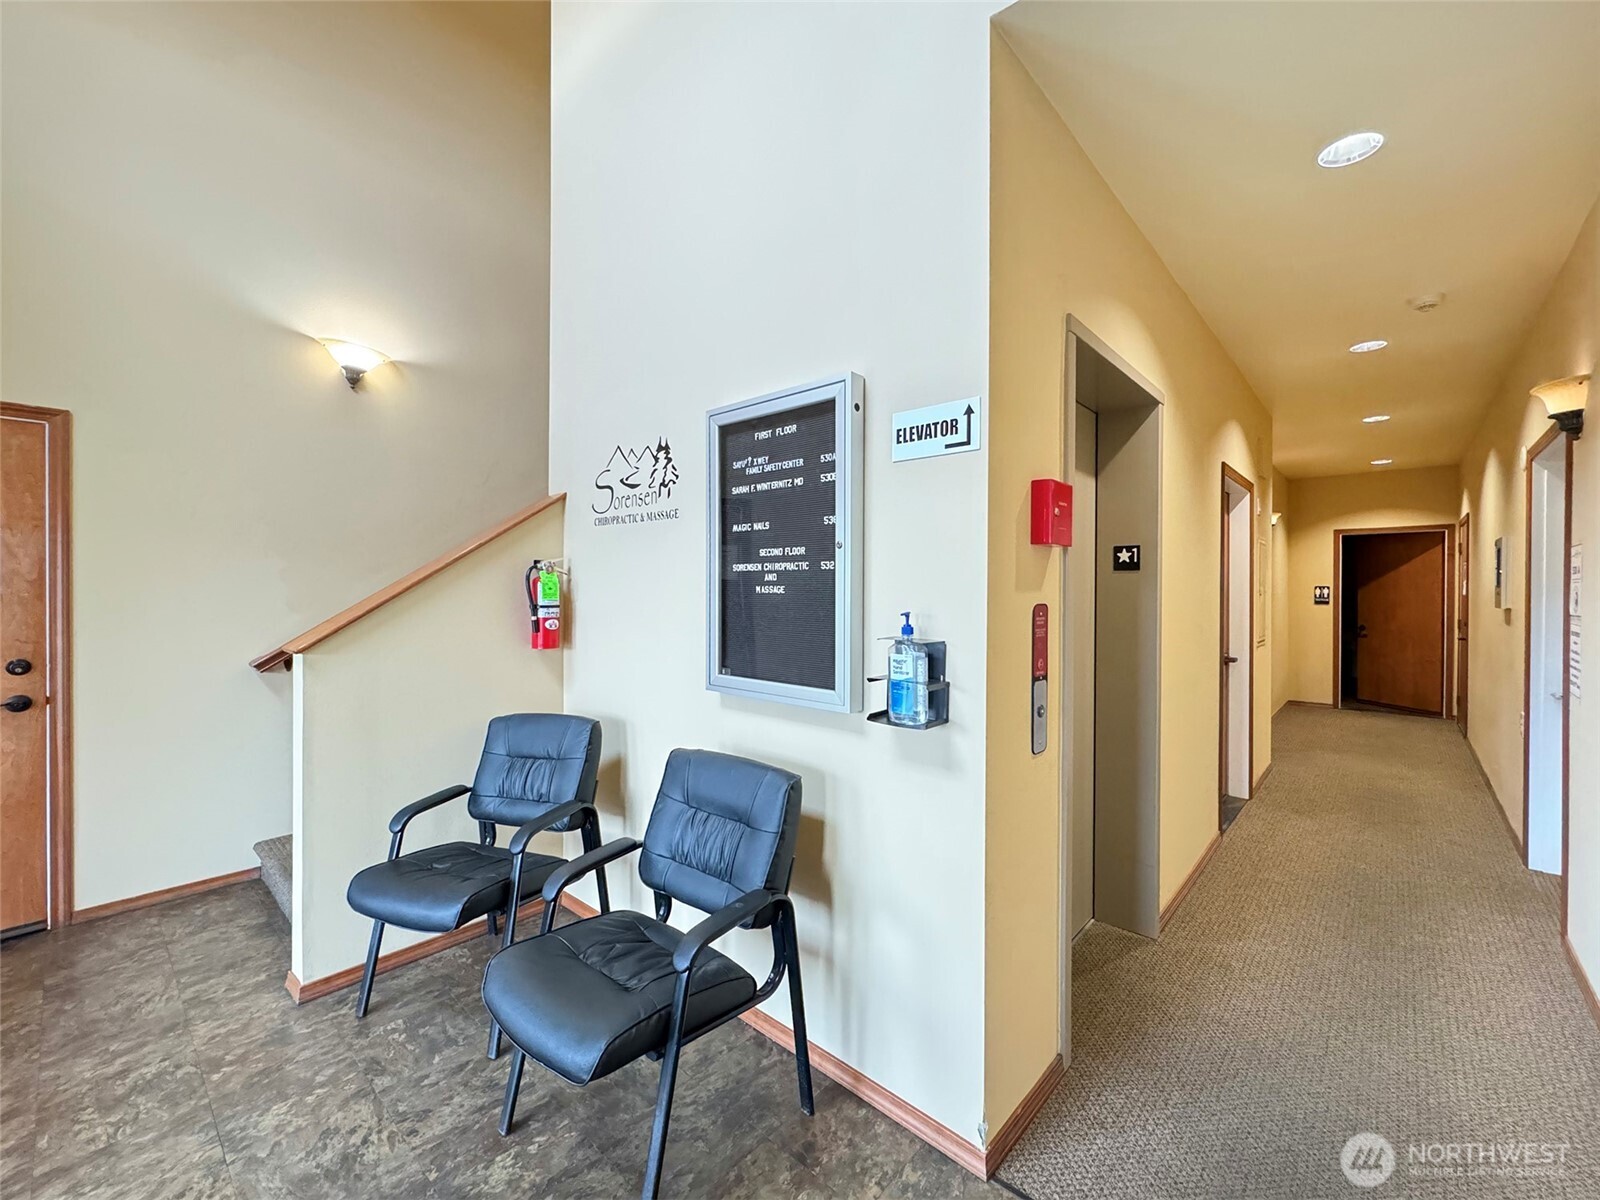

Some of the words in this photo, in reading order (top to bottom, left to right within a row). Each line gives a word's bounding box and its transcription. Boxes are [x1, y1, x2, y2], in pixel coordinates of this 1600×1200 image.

[754, 429, 773, 441] FIRST
[775, 424, 798, 437] FLOOR
[896, 418, 959, 445] ELEVATOR
[745, 464, 763, 476] FAMILY
[763, 462, 783, 473] SAFETY
[781, 458, 805, 470] CENTER
[591, 469, 658, 515] Sorensen
[731, 484, 750, 495] SARAH
[756, 478, 793, 492] WINTERNITZ
[793, 477, 804, 487] MD
[594, 513, 639, 527] CHIROPRACTIC
[640, 512, 646, 522] &
[646, 508, 680, 522] MASSAGE
[732, 523, 752, 533] MAGIC
[753, 521, 770, 531] NAILS
[759, 548, 783, 557] SECOND
[784, 546, 806, 556] FLOOR
[1132, 547, 1138, 563] 1
[732, 563, 762, 572] SORENSEN
[763, 561, 810, 571] CHIROPRACTIC
[820, 560, 835, 570] 532
[764, 572, 778, 582] AND
[755, 585, 786, 594] MASSAGE
